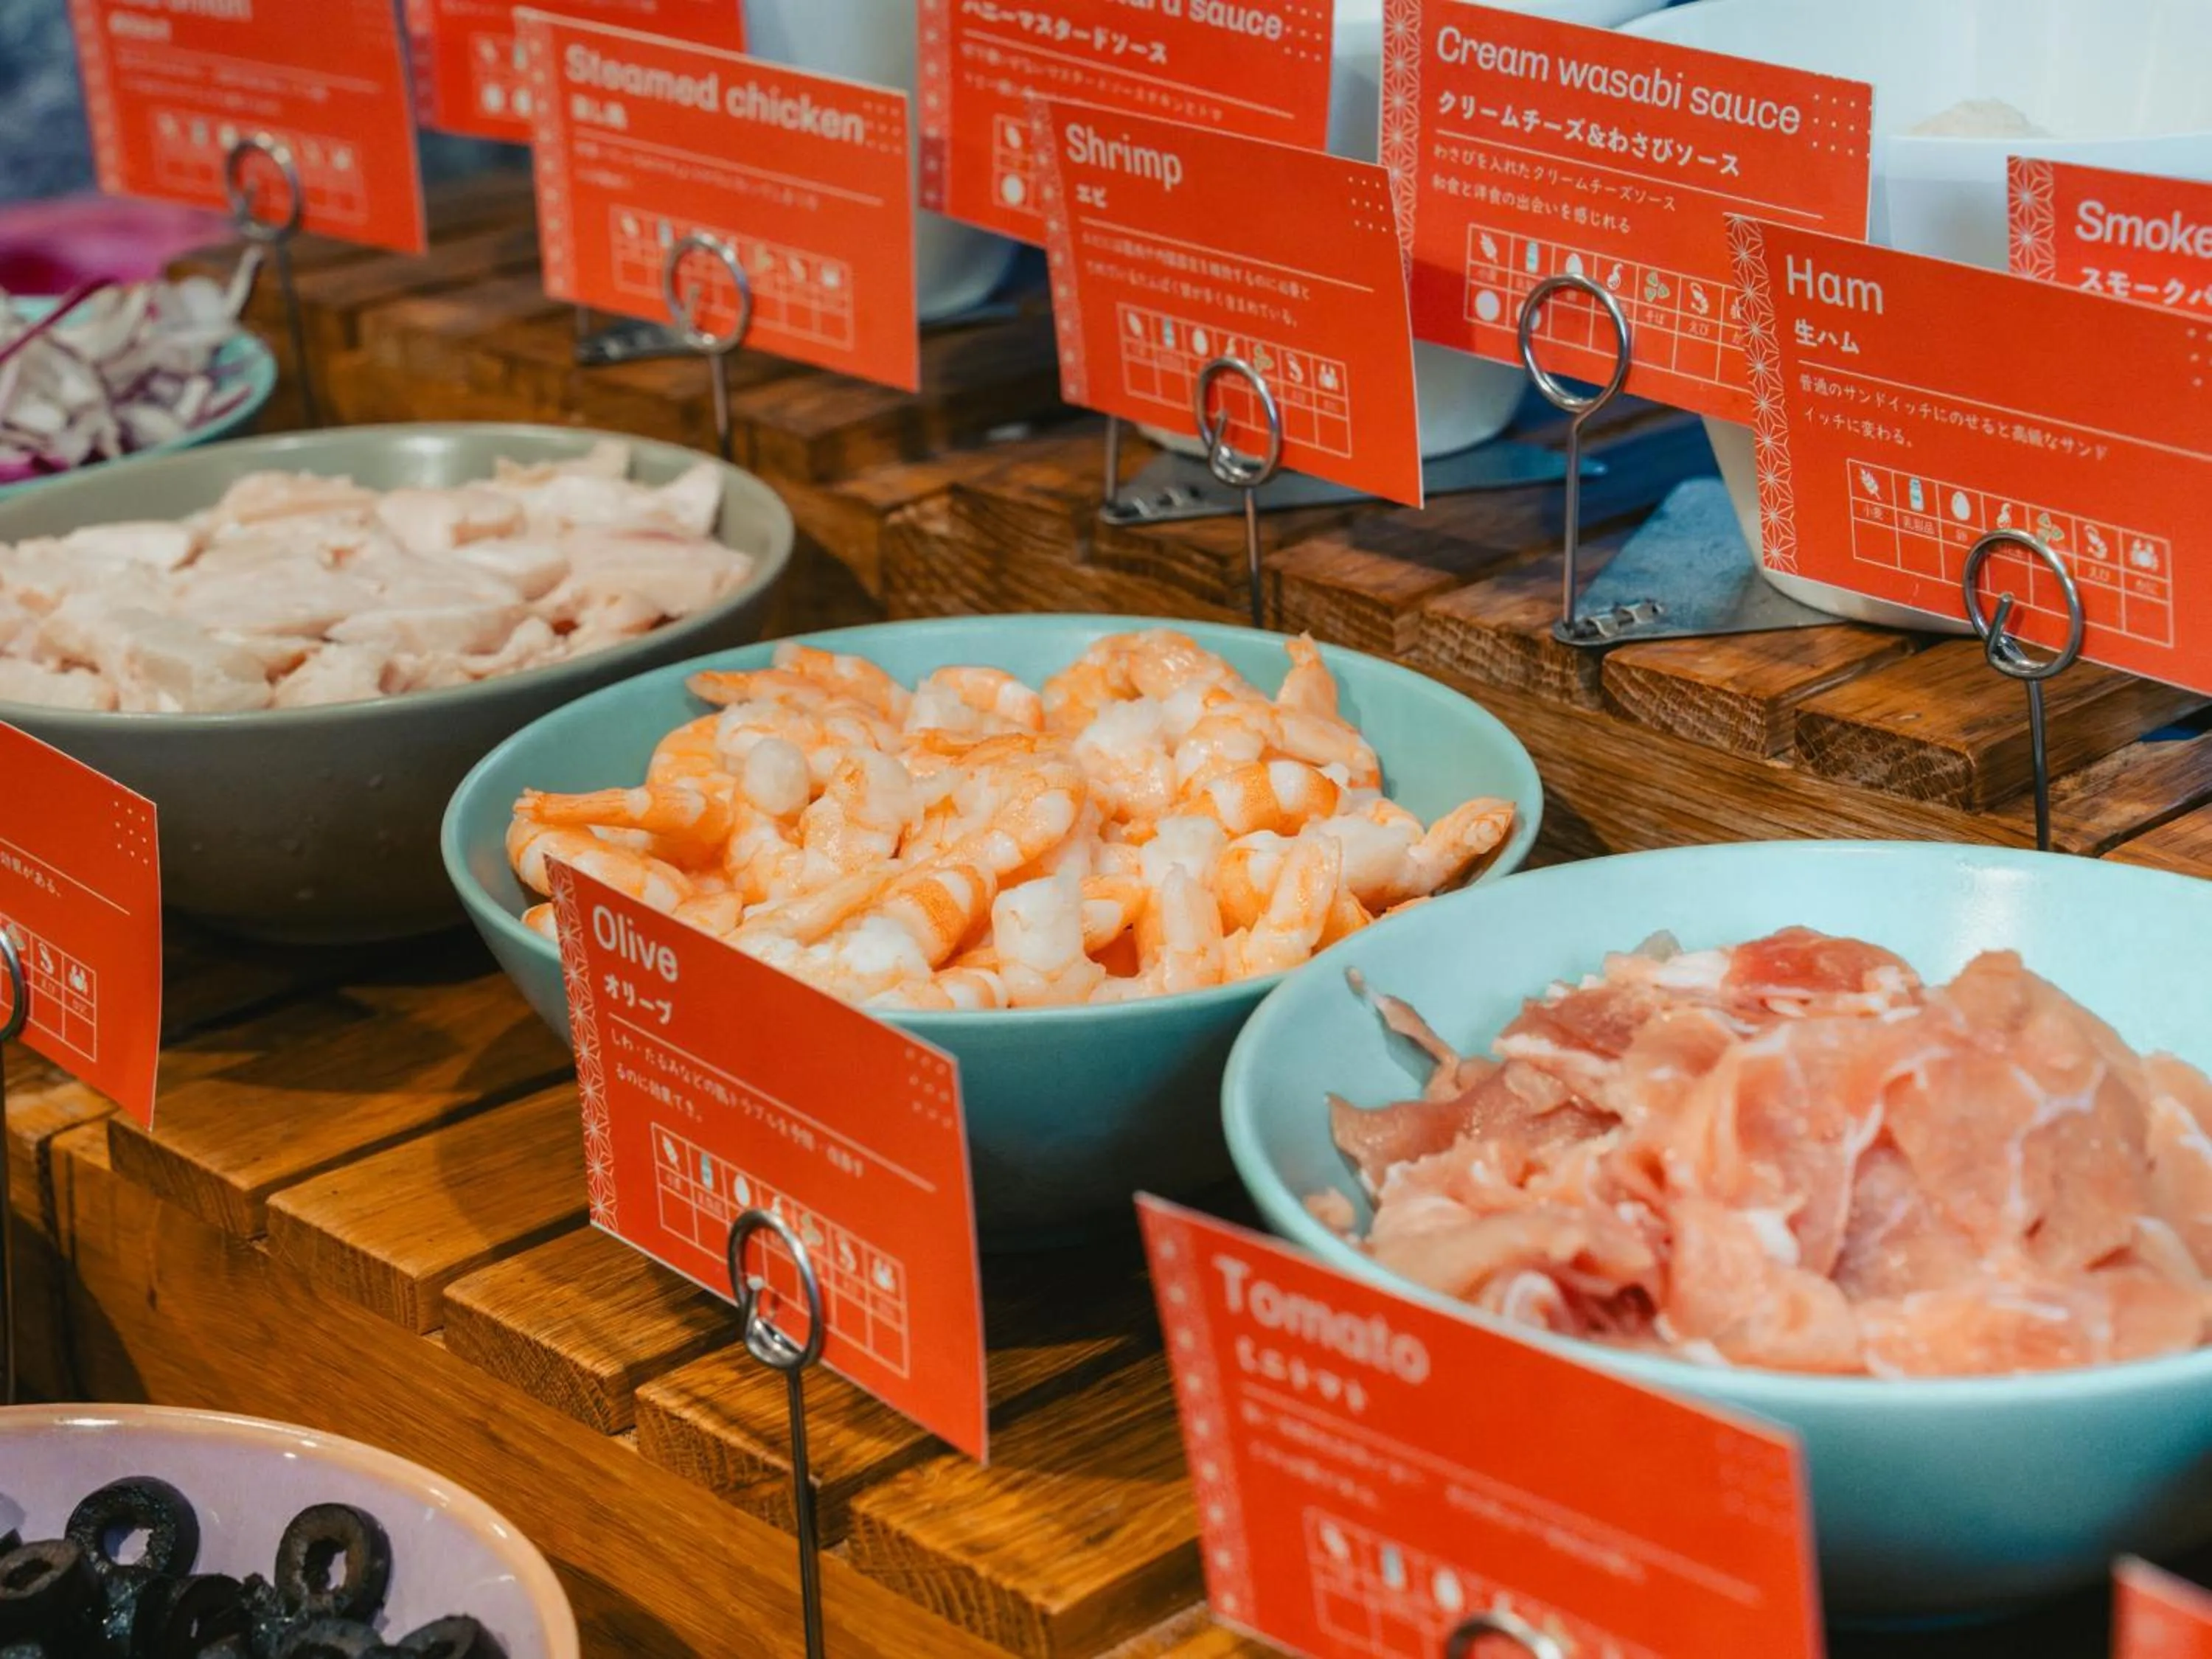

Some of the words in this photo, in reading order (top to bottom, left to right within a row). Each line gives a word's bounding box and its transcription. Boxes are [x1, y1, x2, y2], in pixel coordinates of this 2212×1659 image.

[1189, 0, 1283, 40] sauce
[566, 44, 719, 112] Steamed
[726, 80, 866, 145] chicken
[1436, 25, 1550, 82] Cream
[1557, 57, 1684, 110] wasabi
[1688, 84, 1801, 136] sauce
[1065, 122, 1183, 192] Shrimp
[1439, 90, 1741, 178] クリームチーズ&わさびソース
[1786, 254, 1883, 315] Ham
[1794, 318, 1860, 355] 生ハム
[593, 904, 679, 983] Olive
[1215, 1255, 1430, 1385] Tomato
